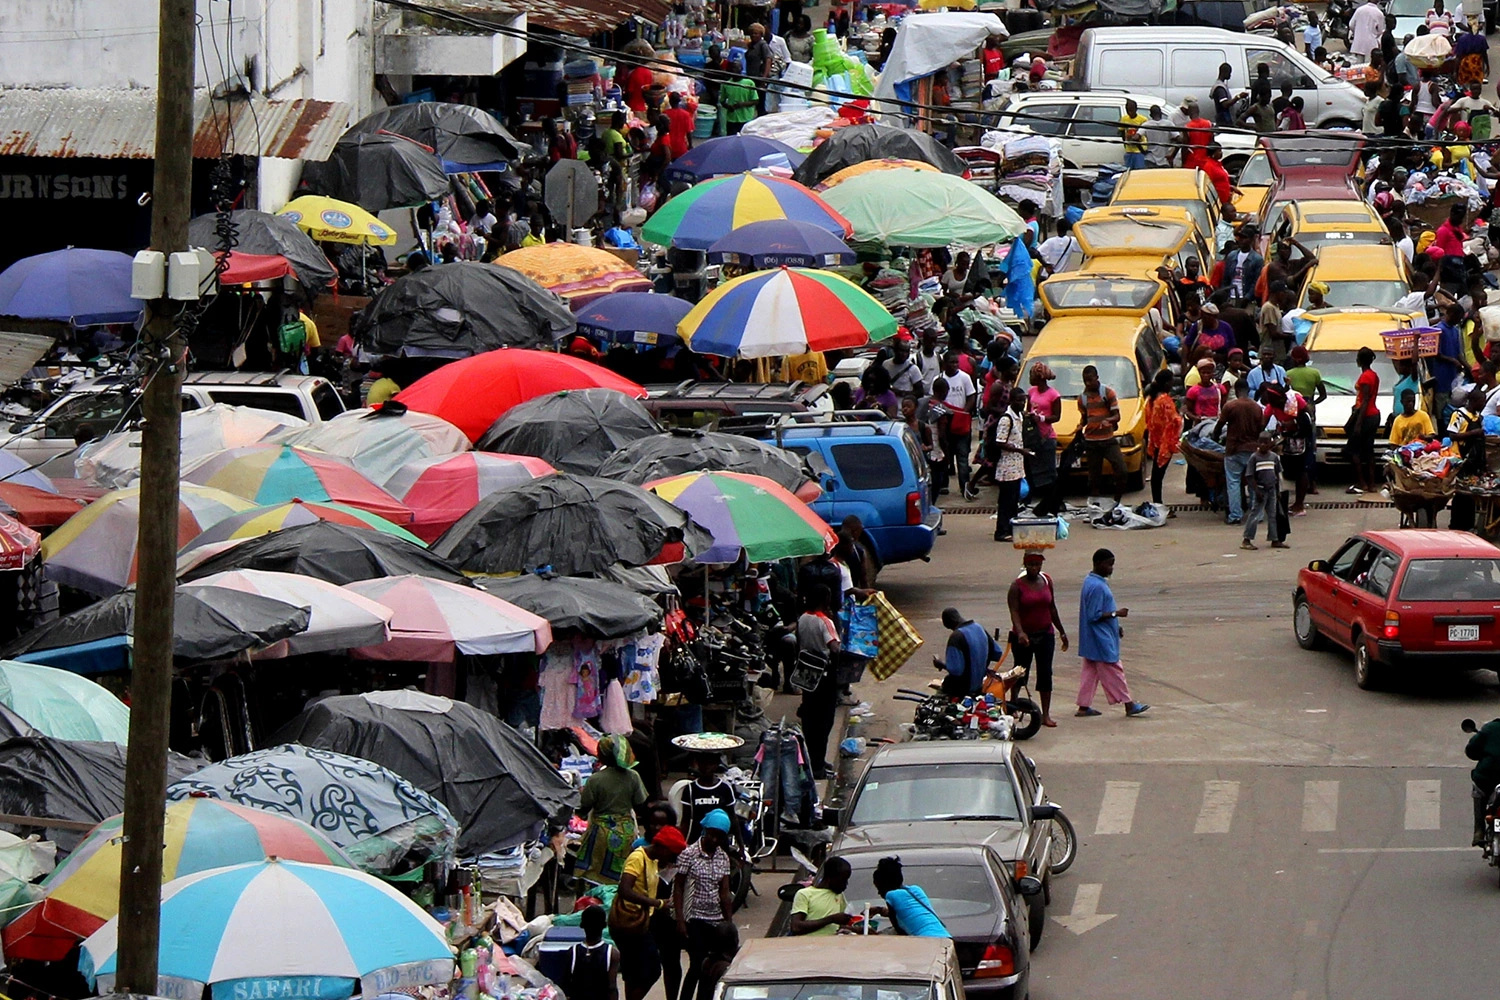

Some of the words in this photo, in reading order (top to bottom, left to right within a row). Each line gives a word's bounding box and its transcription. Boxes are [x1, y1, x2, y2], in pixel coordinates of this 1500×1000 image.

[53, 174, 127, 200] SONS
[1450, 628, 1478, 638] PC-17701
[233, 978, 323, 1000] SAFARI
